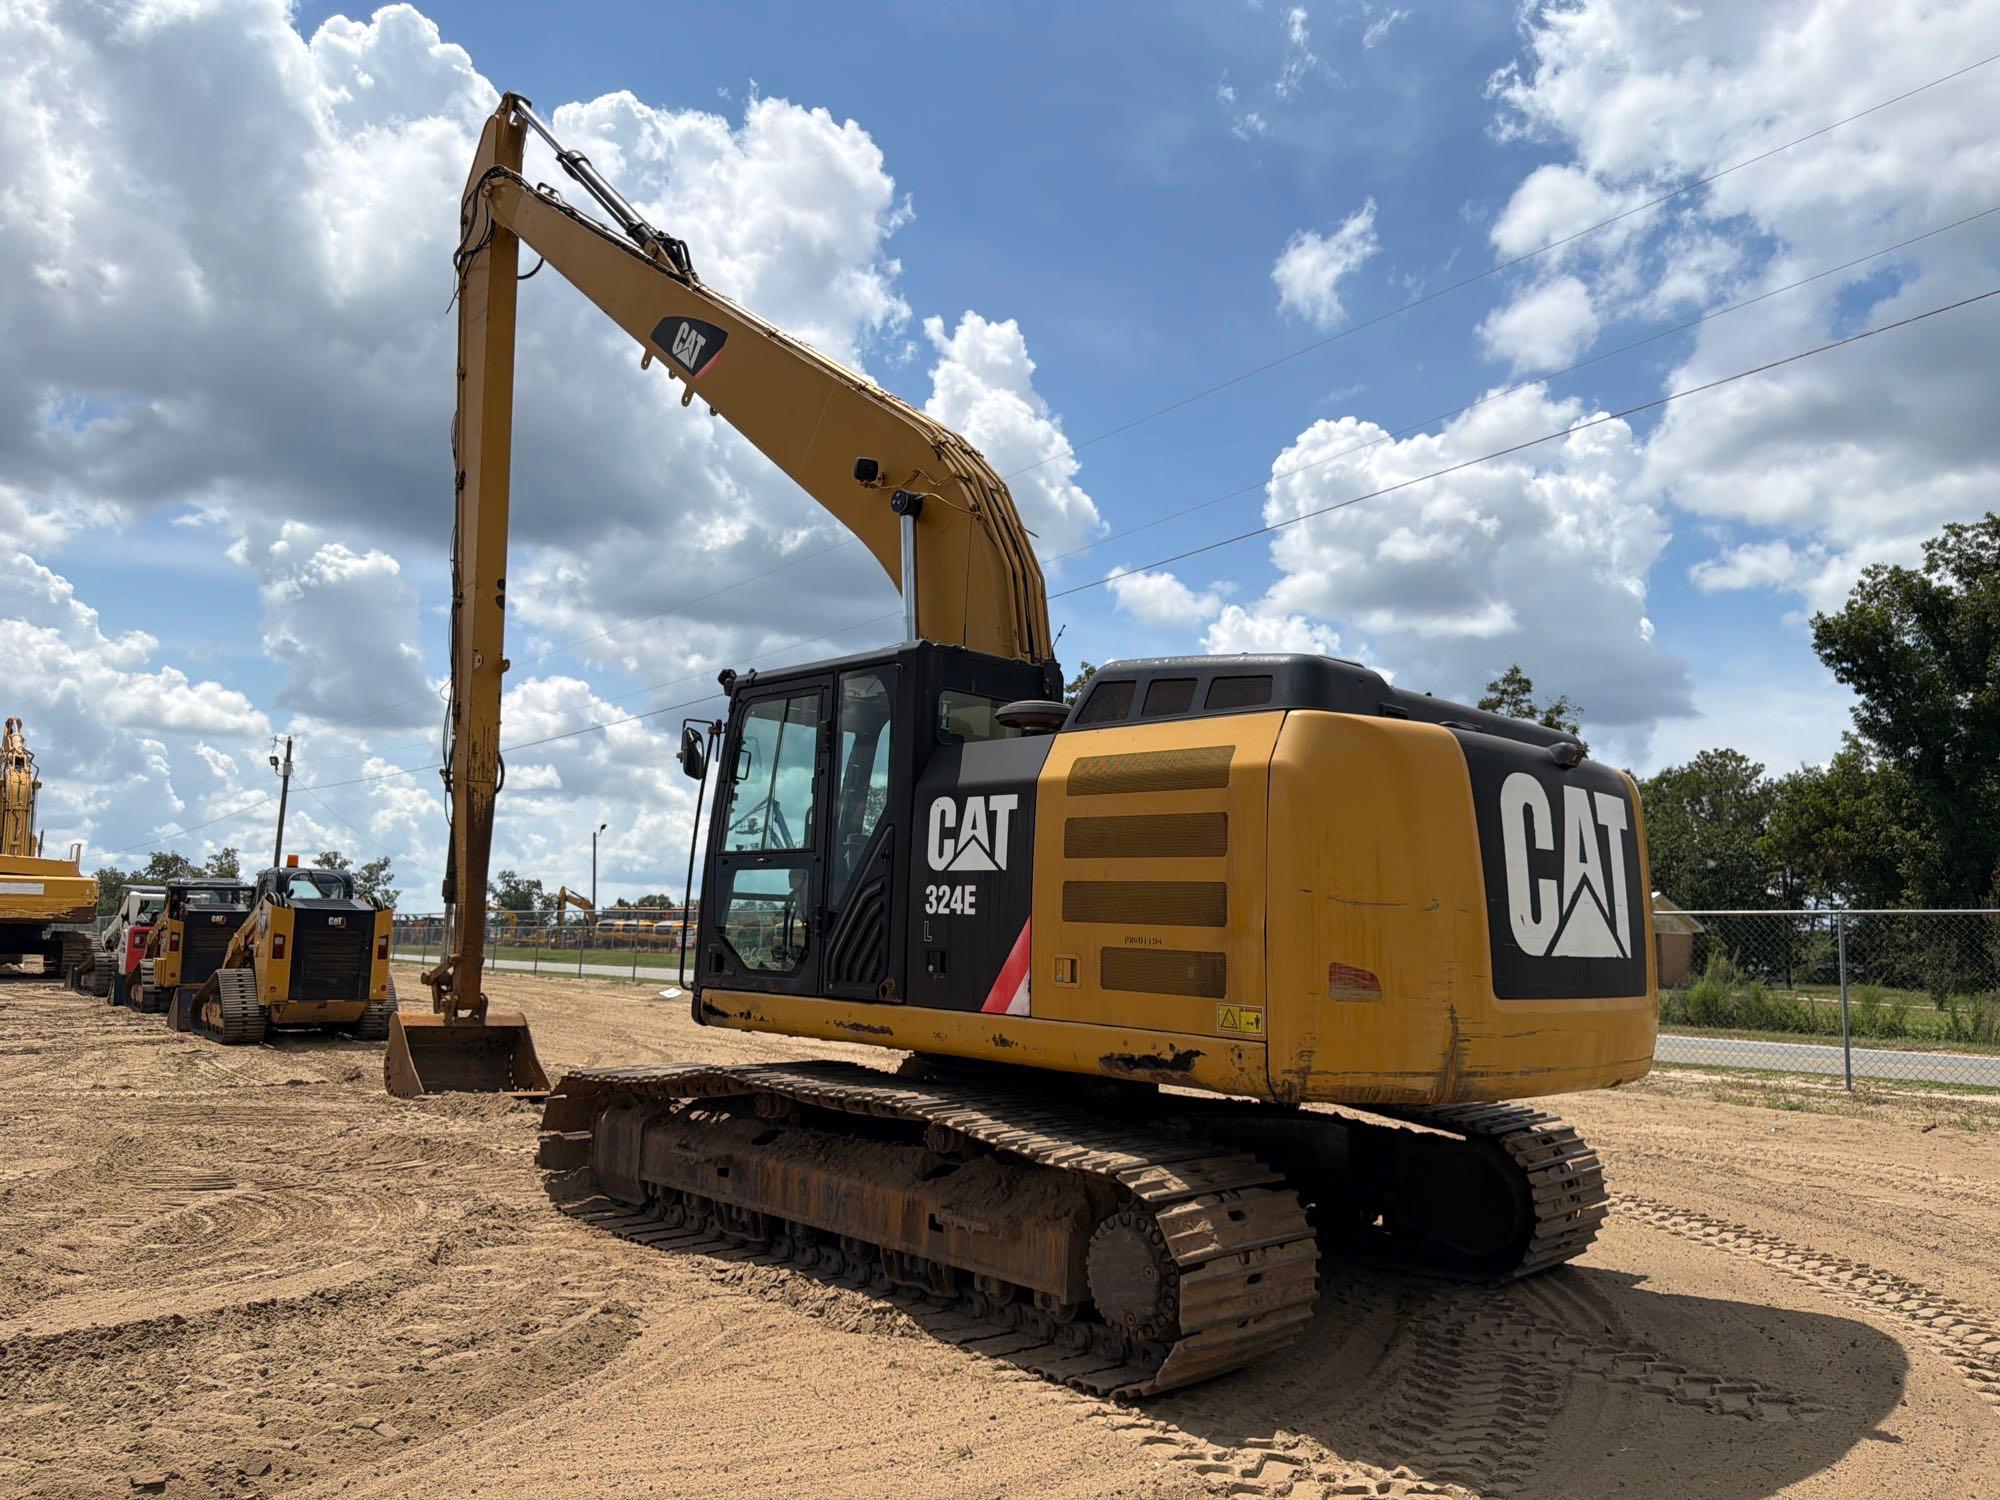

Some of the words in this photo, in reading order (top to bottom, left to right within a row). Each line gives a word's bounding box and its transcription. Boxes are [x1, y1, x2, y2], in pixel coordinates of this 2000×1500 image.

[672, 321, 707, 370] CAT
[927, 794, 1019, 871] CAT
[1500, 772, 1632, 959] CAT
[925, 884, 977, 915] 324E
[211, 915, 224, 923] CAT
[328, 917, 343, 926] CAT
[923, 920, 932, 942] L
